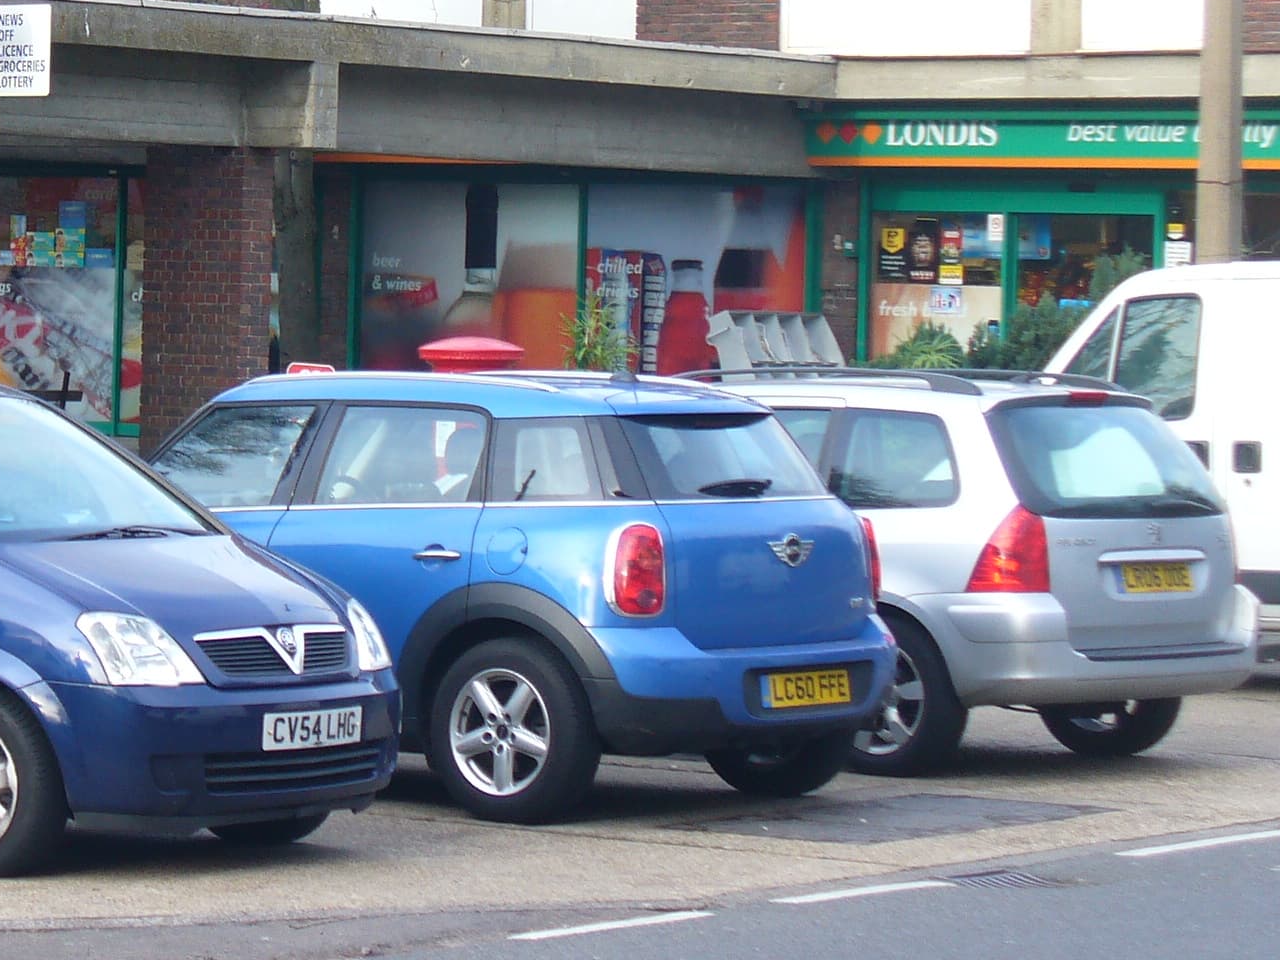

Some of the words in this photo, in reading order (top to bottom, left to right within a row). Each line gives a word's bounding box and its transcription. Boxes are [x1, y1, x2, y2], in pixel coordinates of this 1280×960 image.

[0, 14, 24, 26] NEWS
[885, 121, 998, 147] LONDIS
[1067, 123, 1117, 143] best
[1125, 125, 1185, 143] value
[597, 256, 644, 274] chilled
[372, 275, 382, 290] &
[386, 276, 421, 292] wines
[597, 283, 640, 299] drins
[272, 715, 322, 744] CV54
[326, 711, 357, 740] LHG
